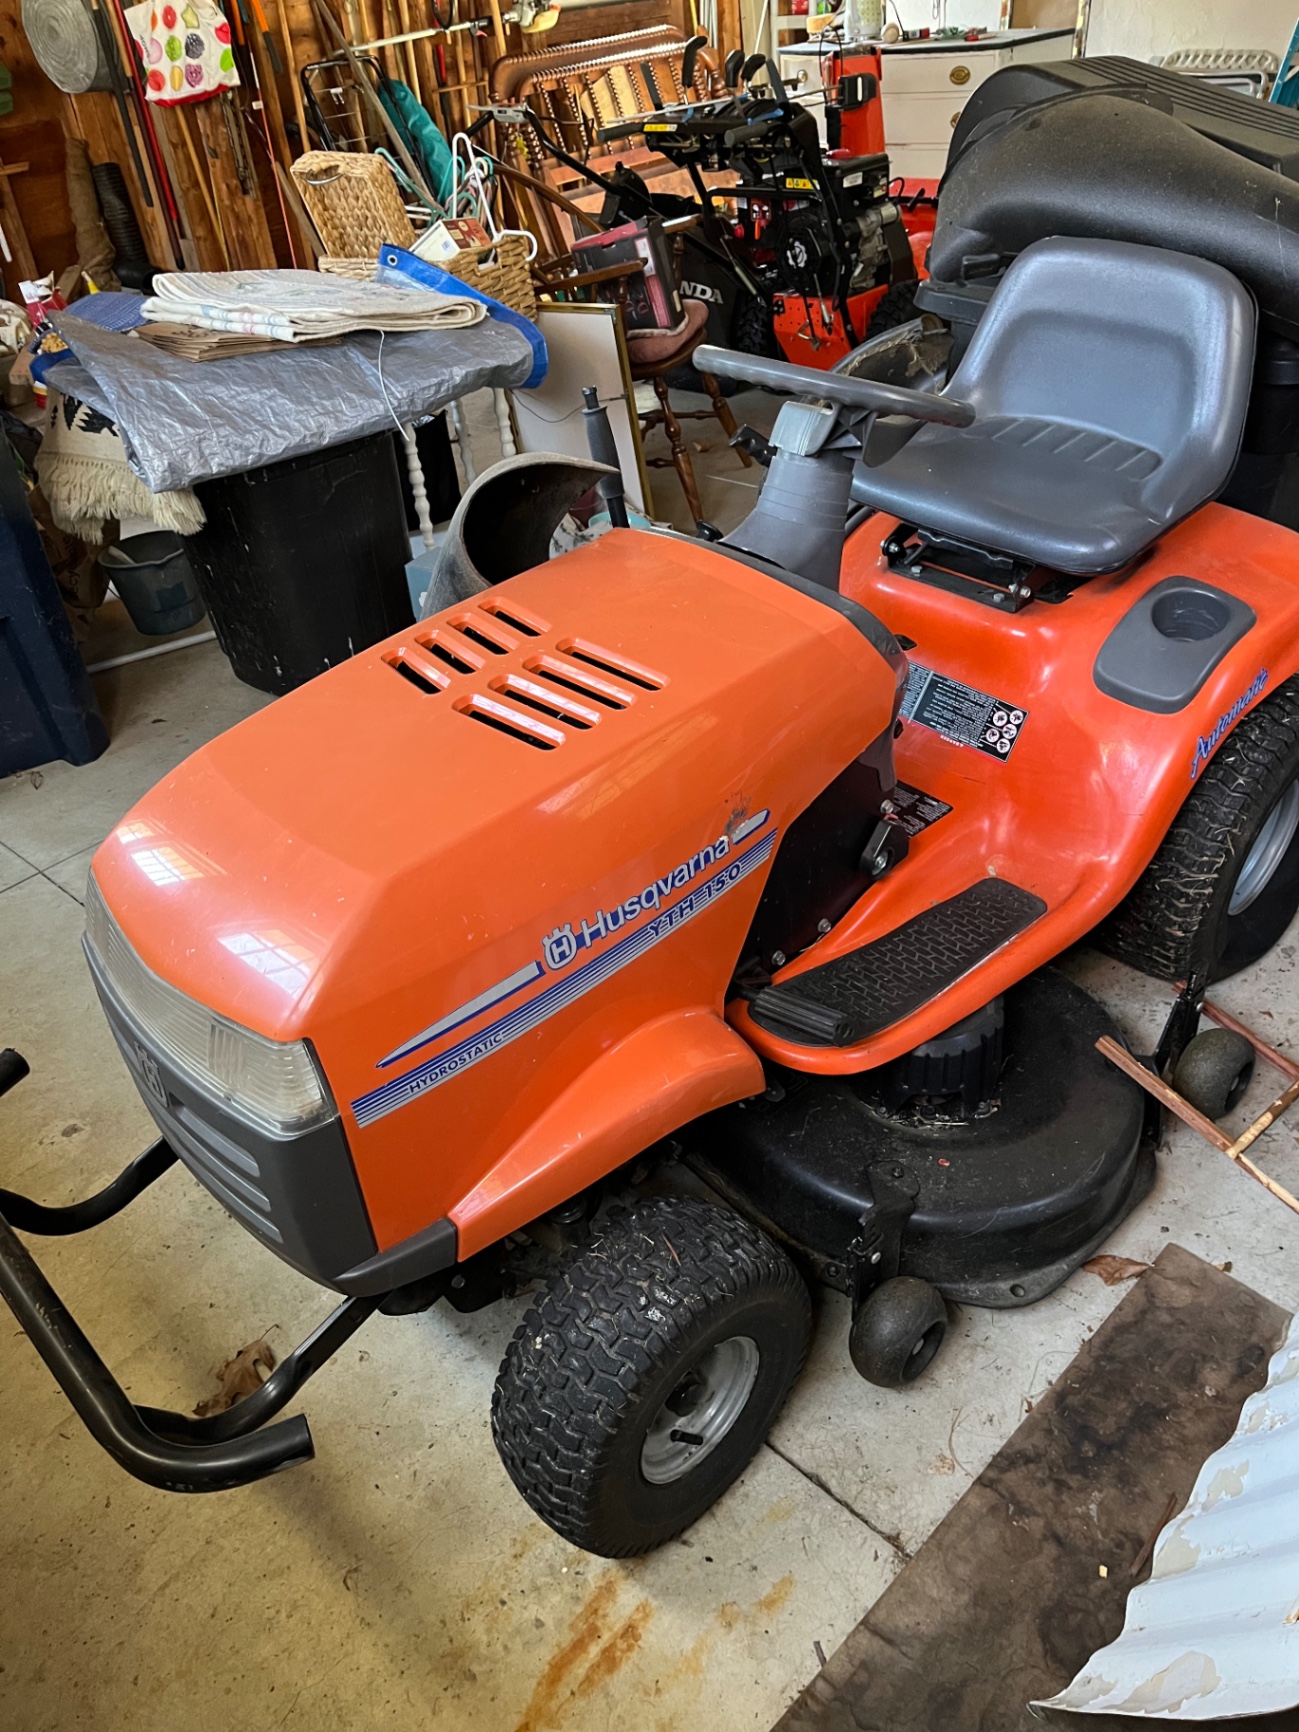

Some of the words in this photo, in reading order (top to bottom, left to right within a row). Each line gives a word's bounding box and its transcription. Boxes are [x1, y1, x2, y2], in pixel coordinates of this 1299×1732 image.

[680, 281, 723, 304] NDA
[1190, 667, 1268, 779] Automatic
[581, 835, 730, 949] Husqvarna
[648, 896, 695, 938] YTH
[704, 863, 742, 899] 150
[408, 1033, 503, 1094] HYDROSTATIC
